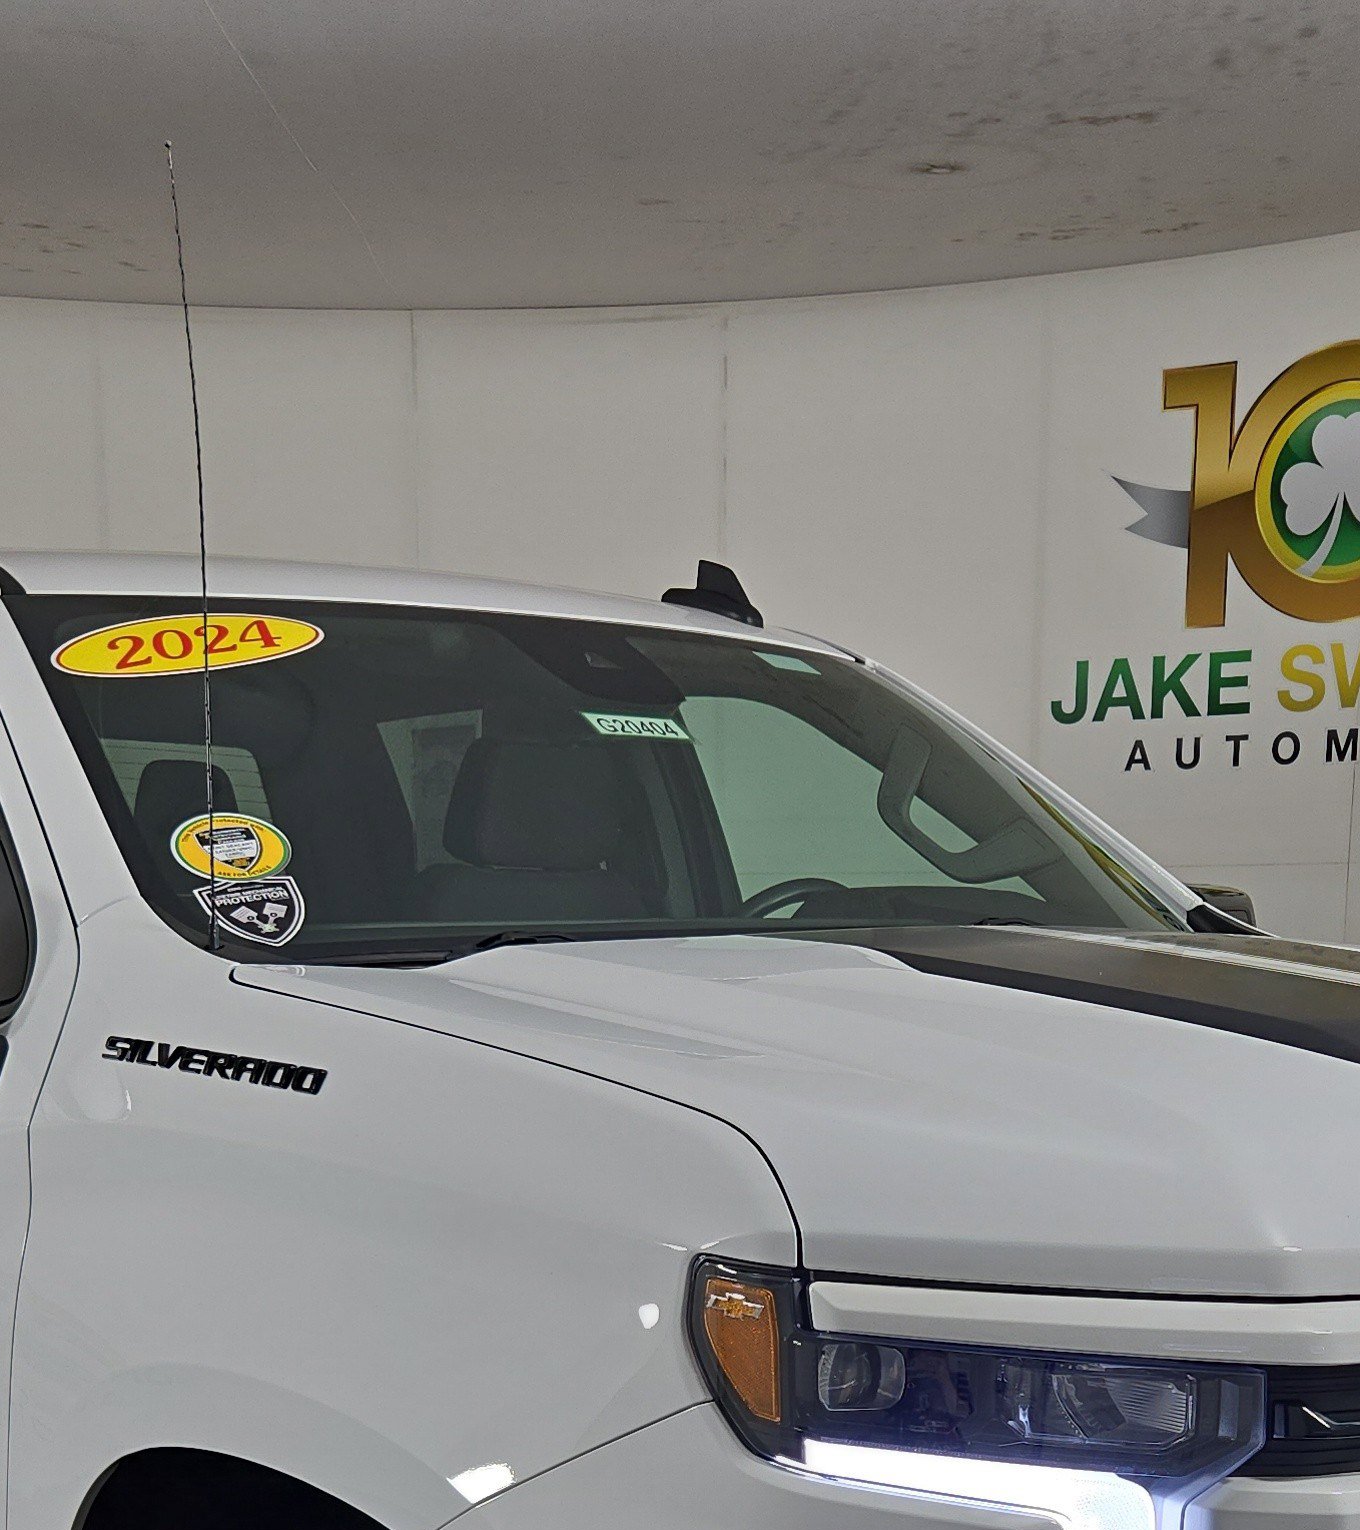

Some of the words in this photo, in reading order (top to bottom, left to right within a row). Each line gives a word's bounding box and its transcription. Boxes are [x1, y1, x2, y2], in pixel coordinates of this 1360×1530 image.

[107, 619, 282, 670] 2024
[1050, 649, 1253, 725] JAKE
[596, 718, 679, 736] G20404
[214, 888, 291, 907] PROTECTION
[101, 1035, 328, 1096] SILVERADO
